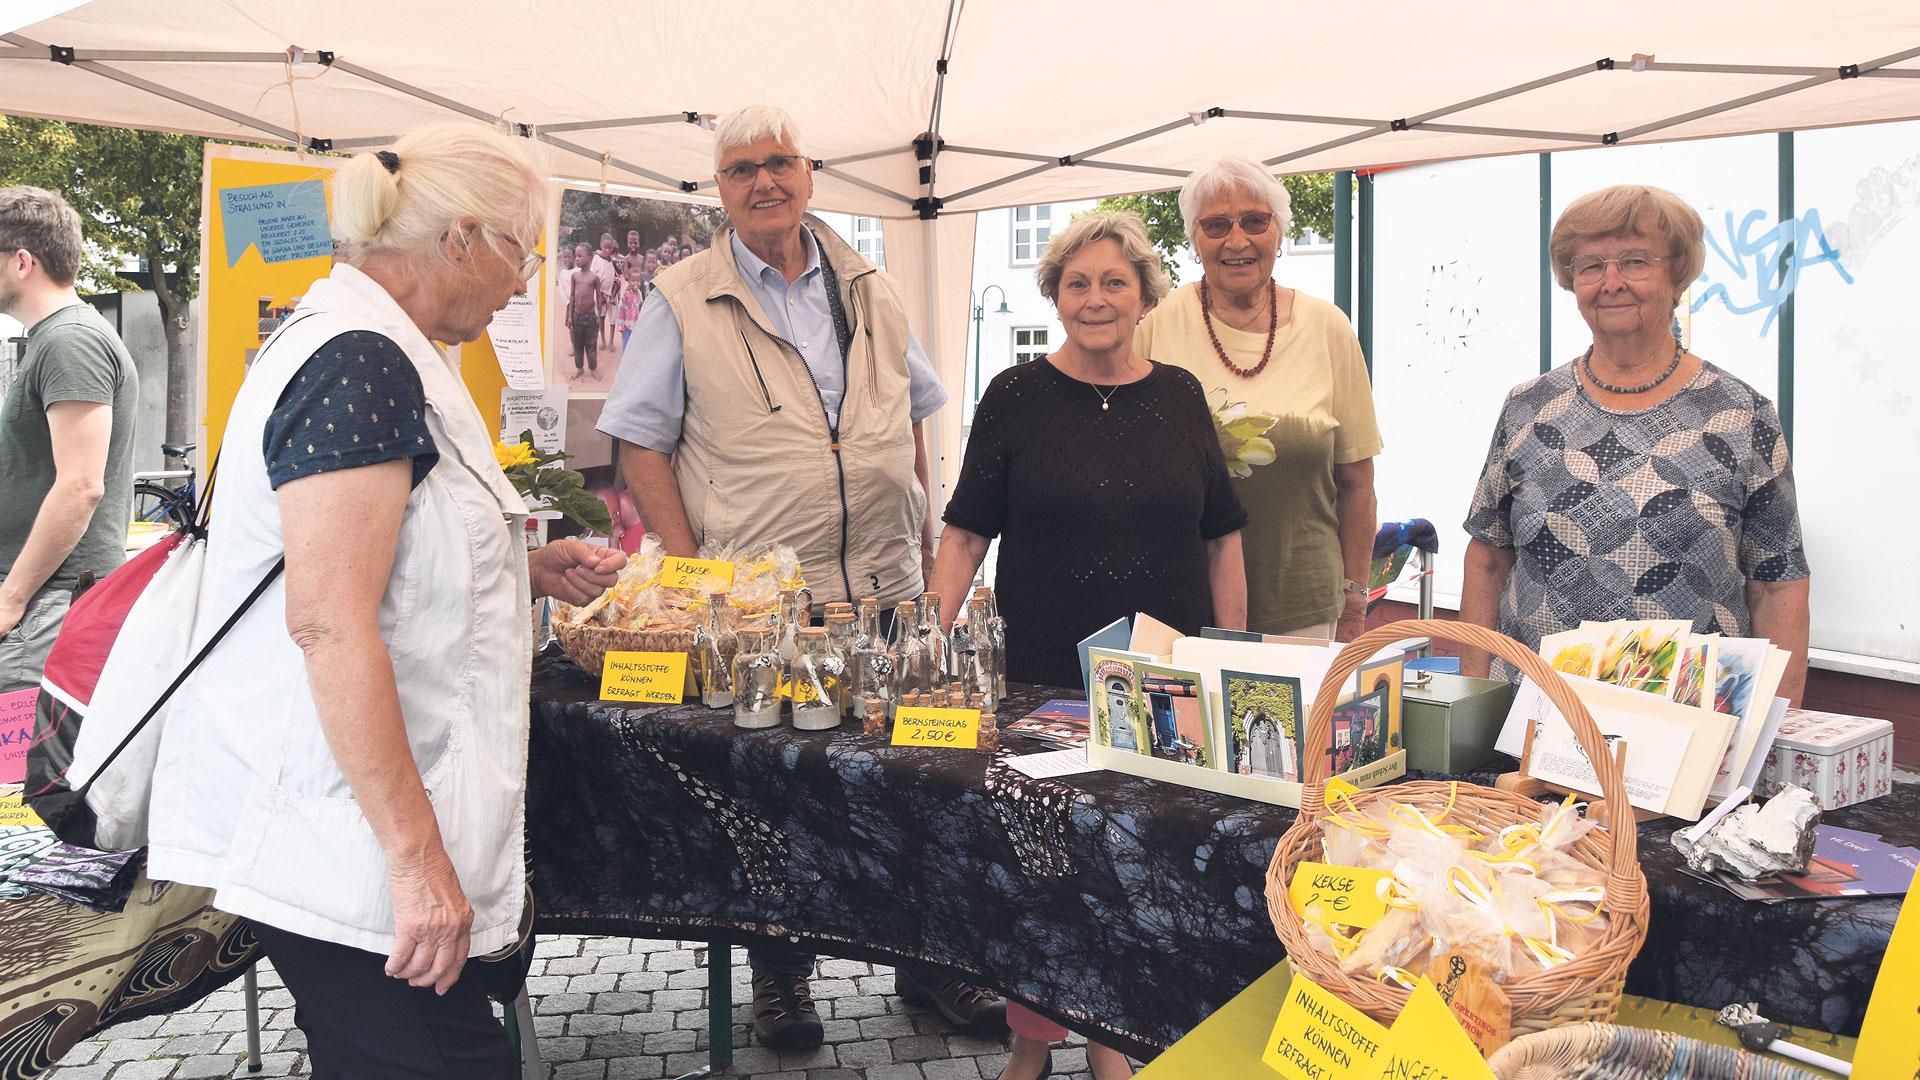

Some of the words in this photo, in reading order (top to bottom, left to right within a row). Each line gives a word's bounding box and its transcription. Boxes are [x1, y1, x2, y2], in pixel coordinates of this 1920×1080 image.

[227, 192, 258, 203] BESUCH
[258, 191, 274, 201] AUS
[228, 202, 273, 214] STRALSUND
[271, 246, 292, 255] GHANA
[610, 661, 671, 674] INHALTSSTOFFE
[620, 673, 653, 684] KÖNNEN
[607, 686, 641, 698] ERFRAGT
[645, 690, 676, 702] WERDEN
[902, 716, 968, 729] BERNSTEINGLAS
[0, 727, 32, 747] KA
[4, 749, 29, 761] UNSE
[1311, 873, 1356, 893] KEKSE
[1295, 989, 1379, 1059] INHALTSSTOFFE
[1454, 1001, 1497, 1037] GREETINGS
[1461, 1019, 1483, 1040] FROM
[1303, 1024, 1352, 1070] KÖNNEN
[1277, 1037, 1326, 1080] ERFRAGT
